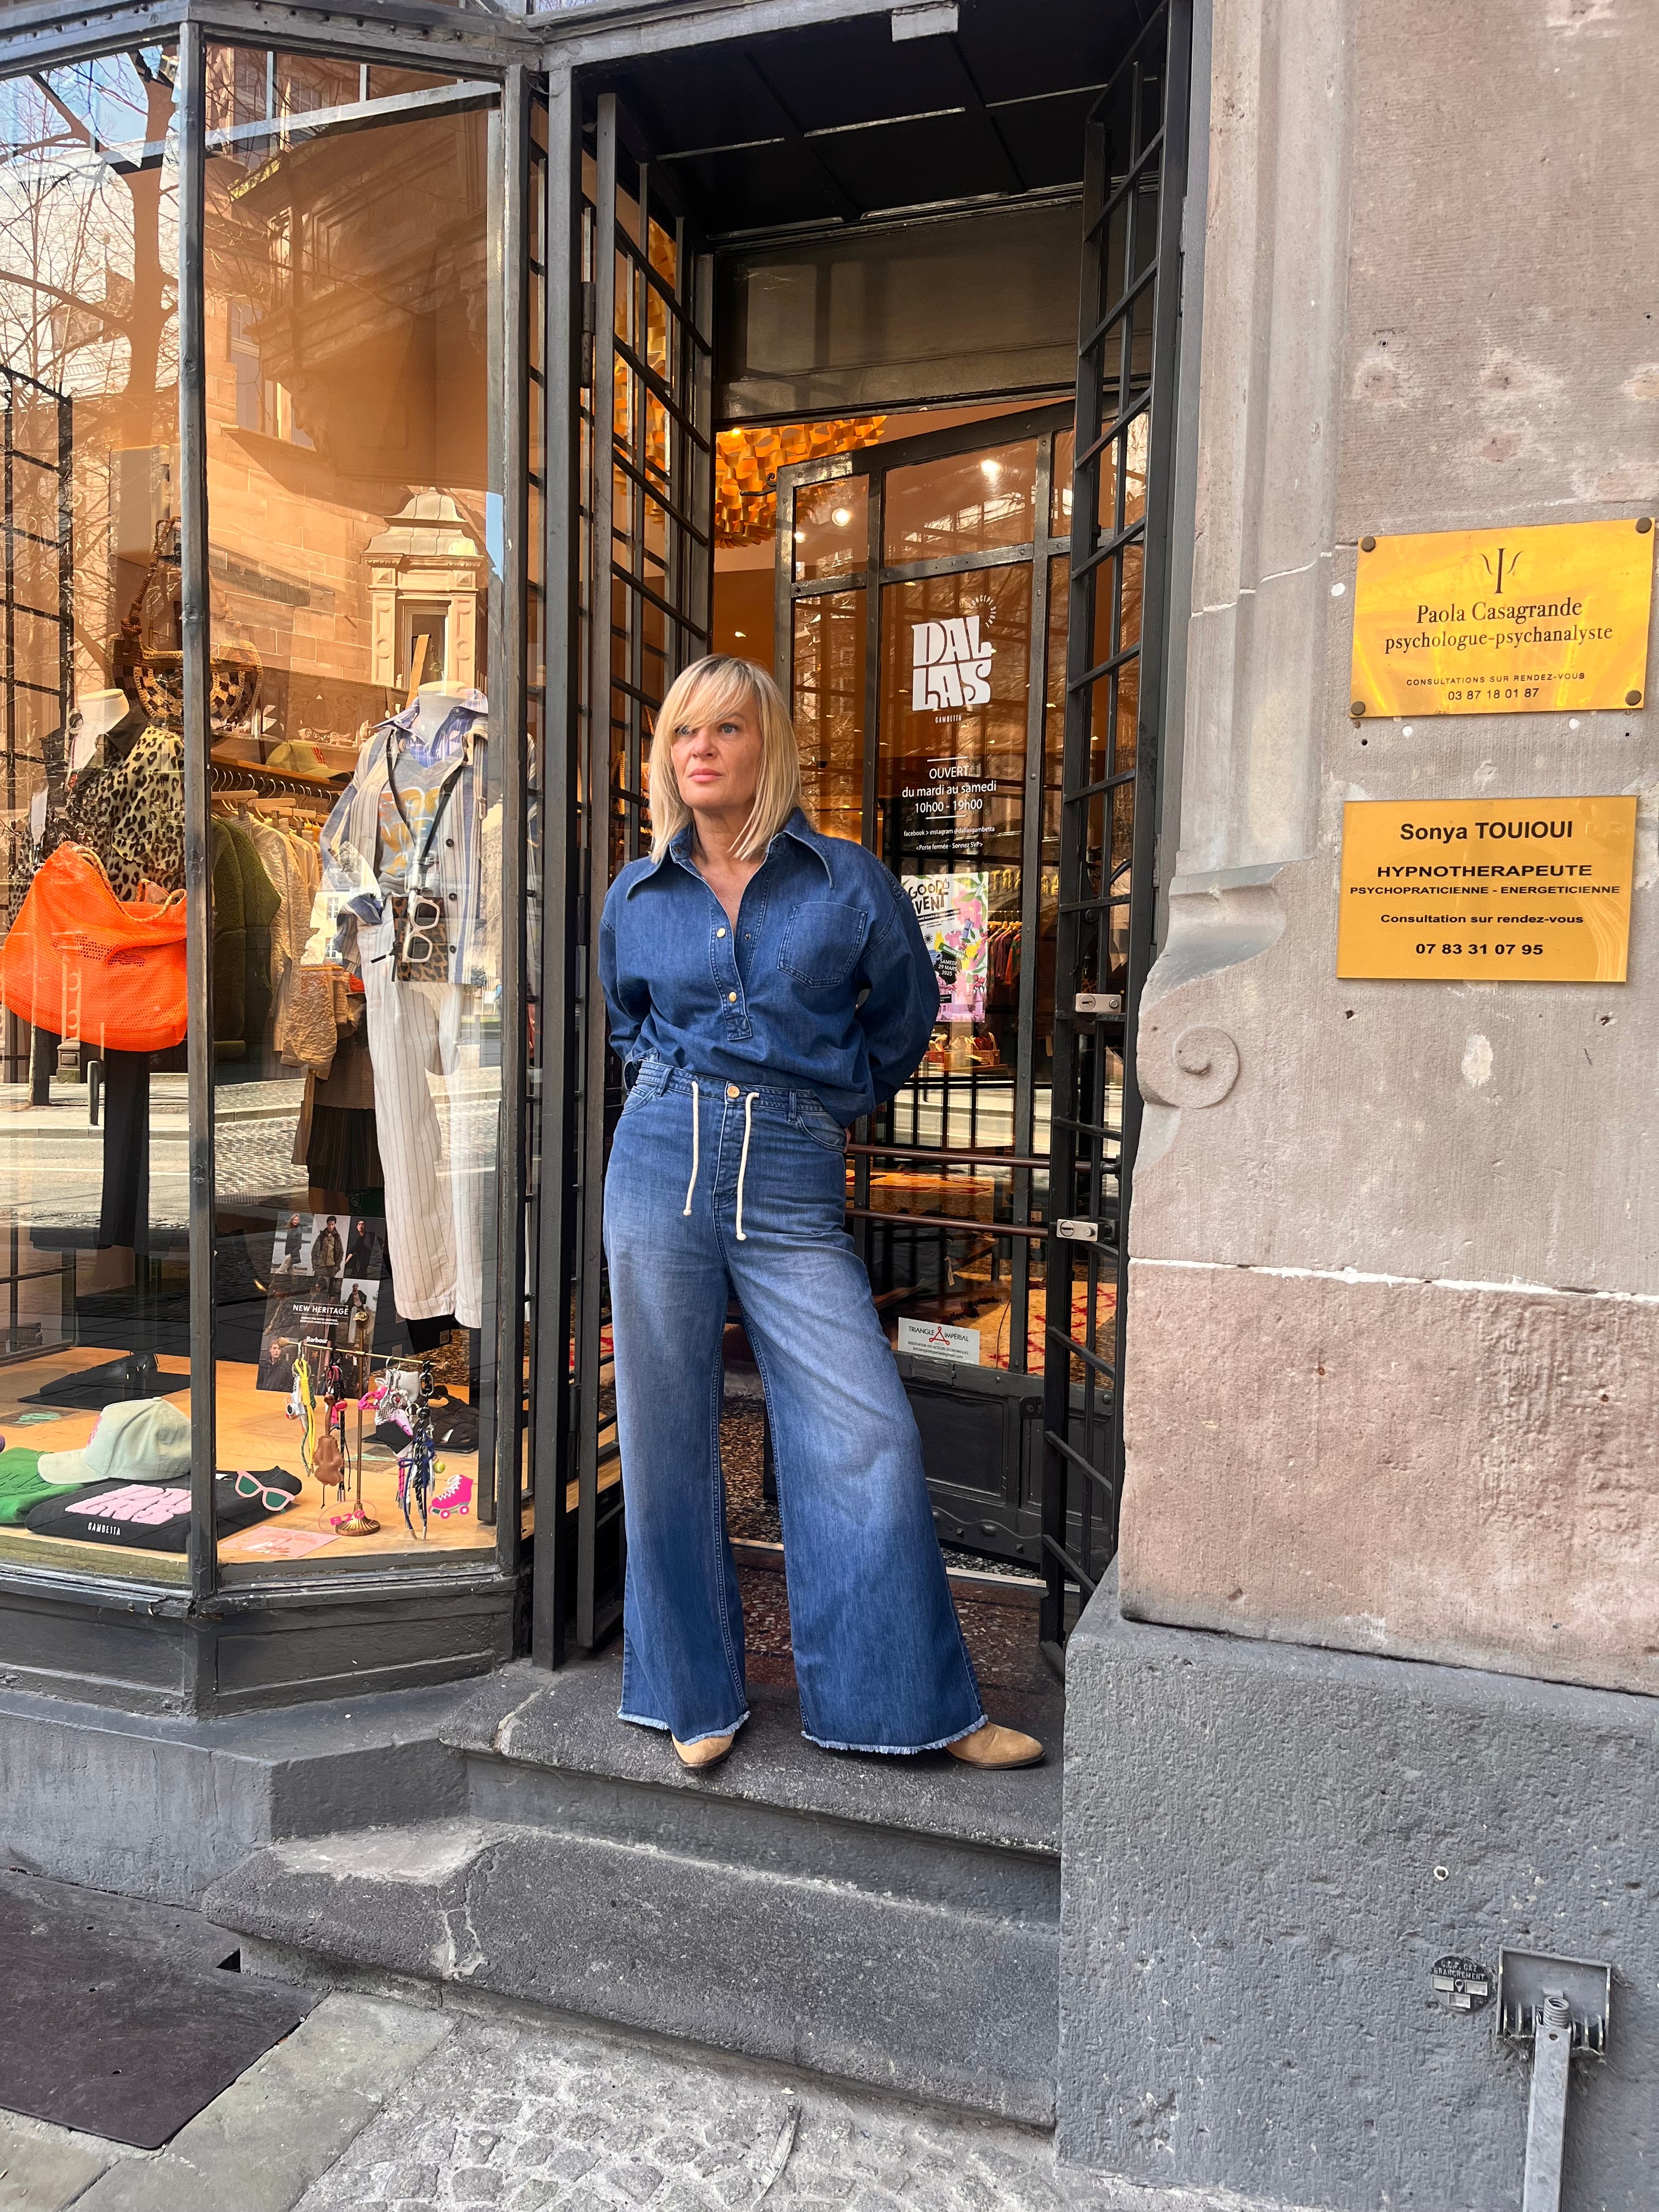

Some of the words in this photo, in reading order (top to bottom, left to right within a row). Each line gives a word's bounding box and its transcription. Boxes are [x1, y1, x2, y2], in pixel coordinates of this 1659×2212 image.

[968, 595, 994, 609] CONCEPT
[985, 606, 996, 628] STORE
[1417, 603, 1466, 624] Paola
[1471, 597, 1583, 625] Casagrande
[1384, 624, 1613, 654] psychologue-psychanalyste
[1406, 676, 1485, 686] CONSULTATIONS
[1514, 673, 1585, 682] RENDEZ-VOUS
[1448, 691, 1462, 701] 03
[1466, 690, 1481, 700] 87
[1487, 689, 1500, 699] 18
[1505, 689, 1519, 699] 01
[1524, 687, 1539, 698] 87
[935, 715, 962, 724] GAMBETTA
[929, 766, 969, 779] OUVERT
[902, 787, 915, 798] du
[917, 785, 944, 797] mardi
[946, 787, 958, 795] au
[961, 780, 997, 794] samedi
[915, 801, 944, 813] 10h00
[953, 799, 983, 811] 19h00
[953, 826, 995, 834] @dallasgambetta
[1400, 823, 1468, 844] Sonya
[1475, 821, 1573, 840] TOUIOUI
[1377, 865, 1593, 878] HYPNOTHERAPEUTE
[1350, 886, 1489, 895] PSYCHOPRATICIENNE
[1500, 885, 1621, 895] ENERGETICIENNE
[1380, 914, 1466, 924] Consultation
[1497, 914, 1584, 924] rendez-vous
[1415, 944, 1436, 955] 07
[1441, 944, 1463, 955] 83
[1468, 944, 1487, 955] 31
[1494, 944, 1515, 955] 07
[1521, 944, 1544, 955] 95
[312, 1306, 349, 1315] HERITAGE
[908, 1326, 934, 1335] TRIANGLE
[944, 1332, 969, 1342] IMPÉRIAL
[88, 1522, 121, 1536] GAMBETTA
